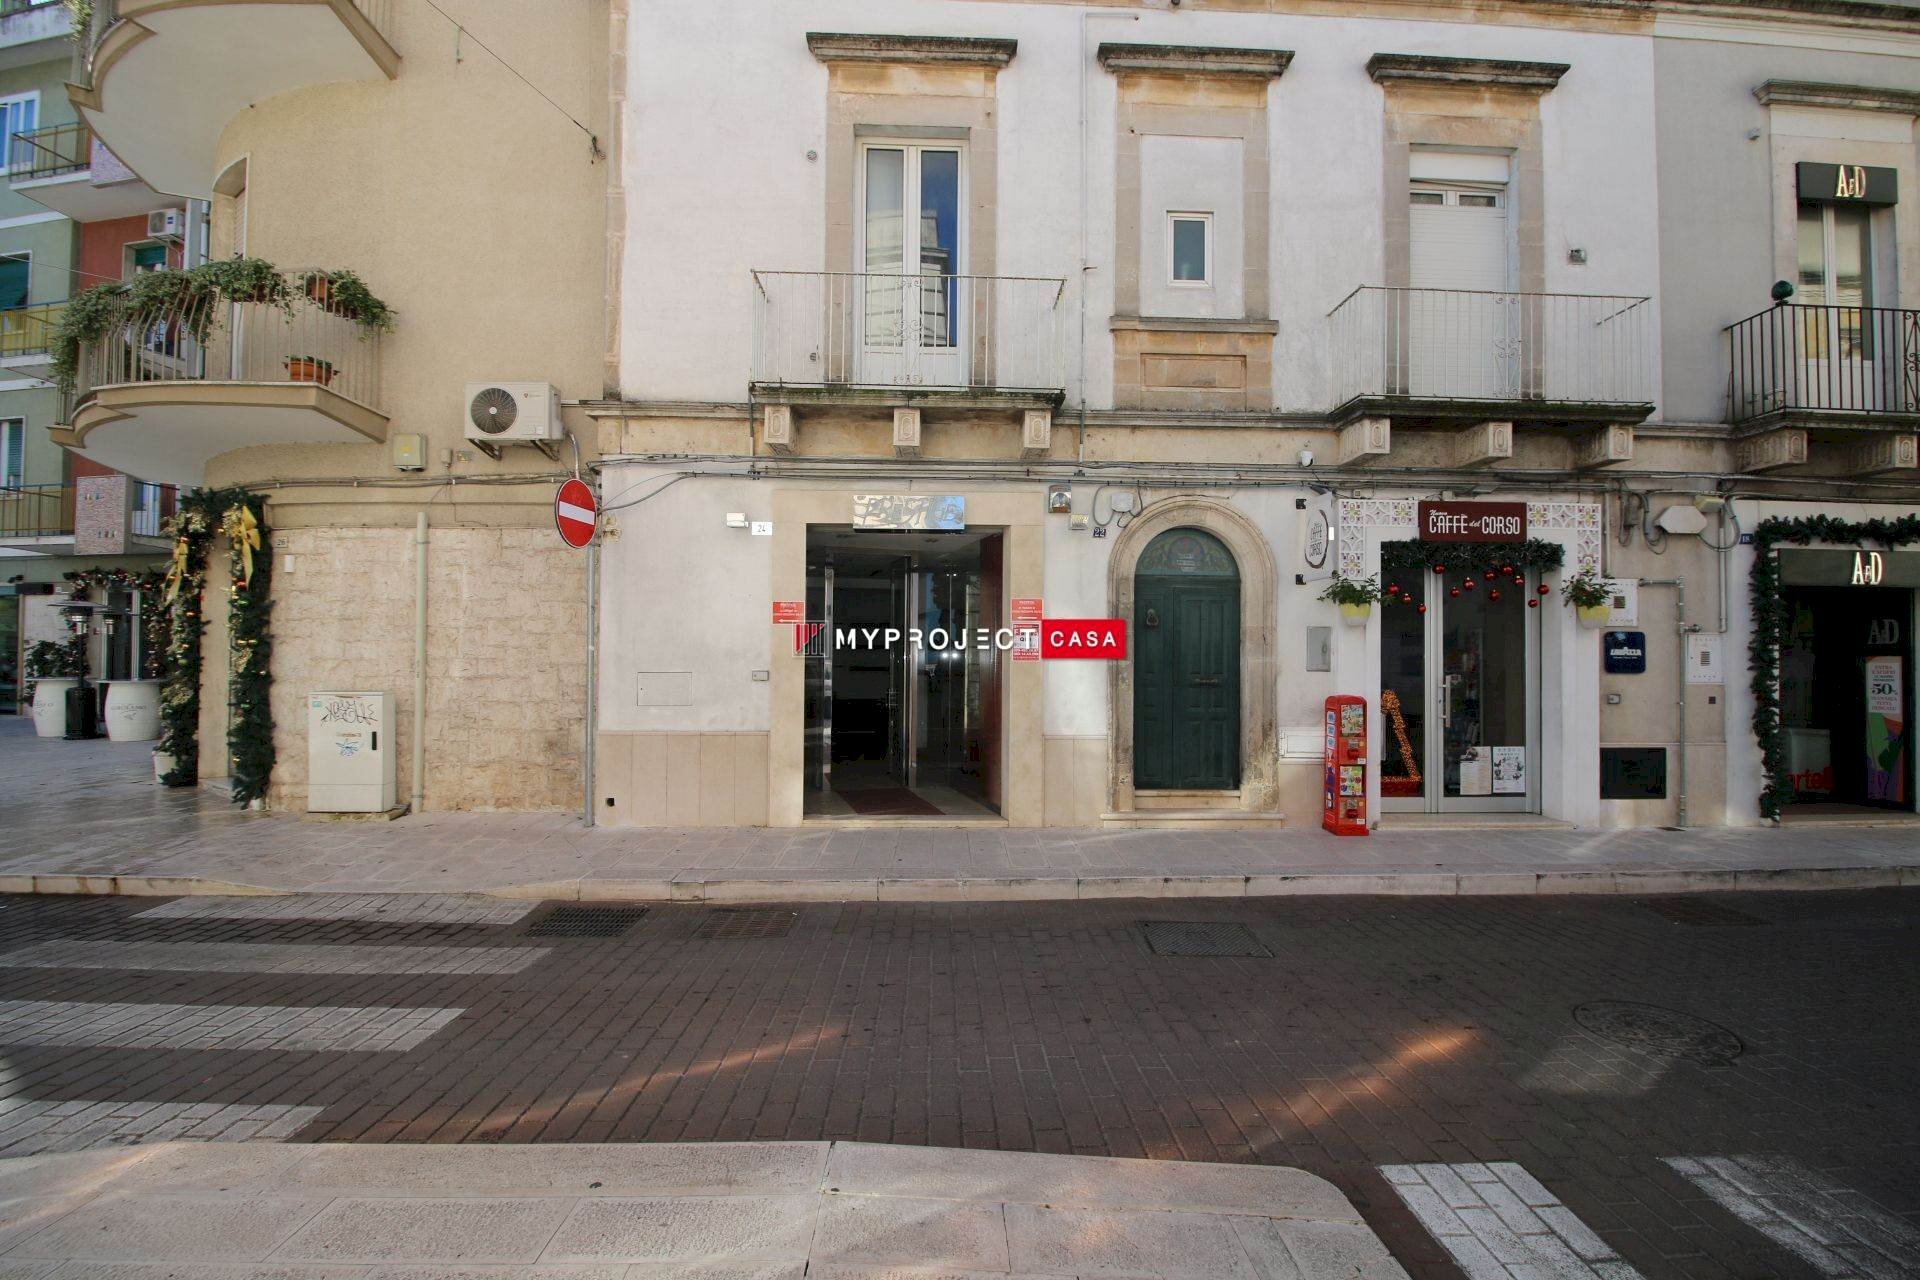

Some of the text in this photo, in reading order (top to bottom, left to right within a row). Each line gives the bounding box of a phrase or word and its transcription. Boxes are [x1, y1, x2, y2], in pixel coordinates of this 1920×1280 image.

[1429, 513, 1520, 535] CAFFÈ del CORSO
[1094, 527, 1106, 538] 22
